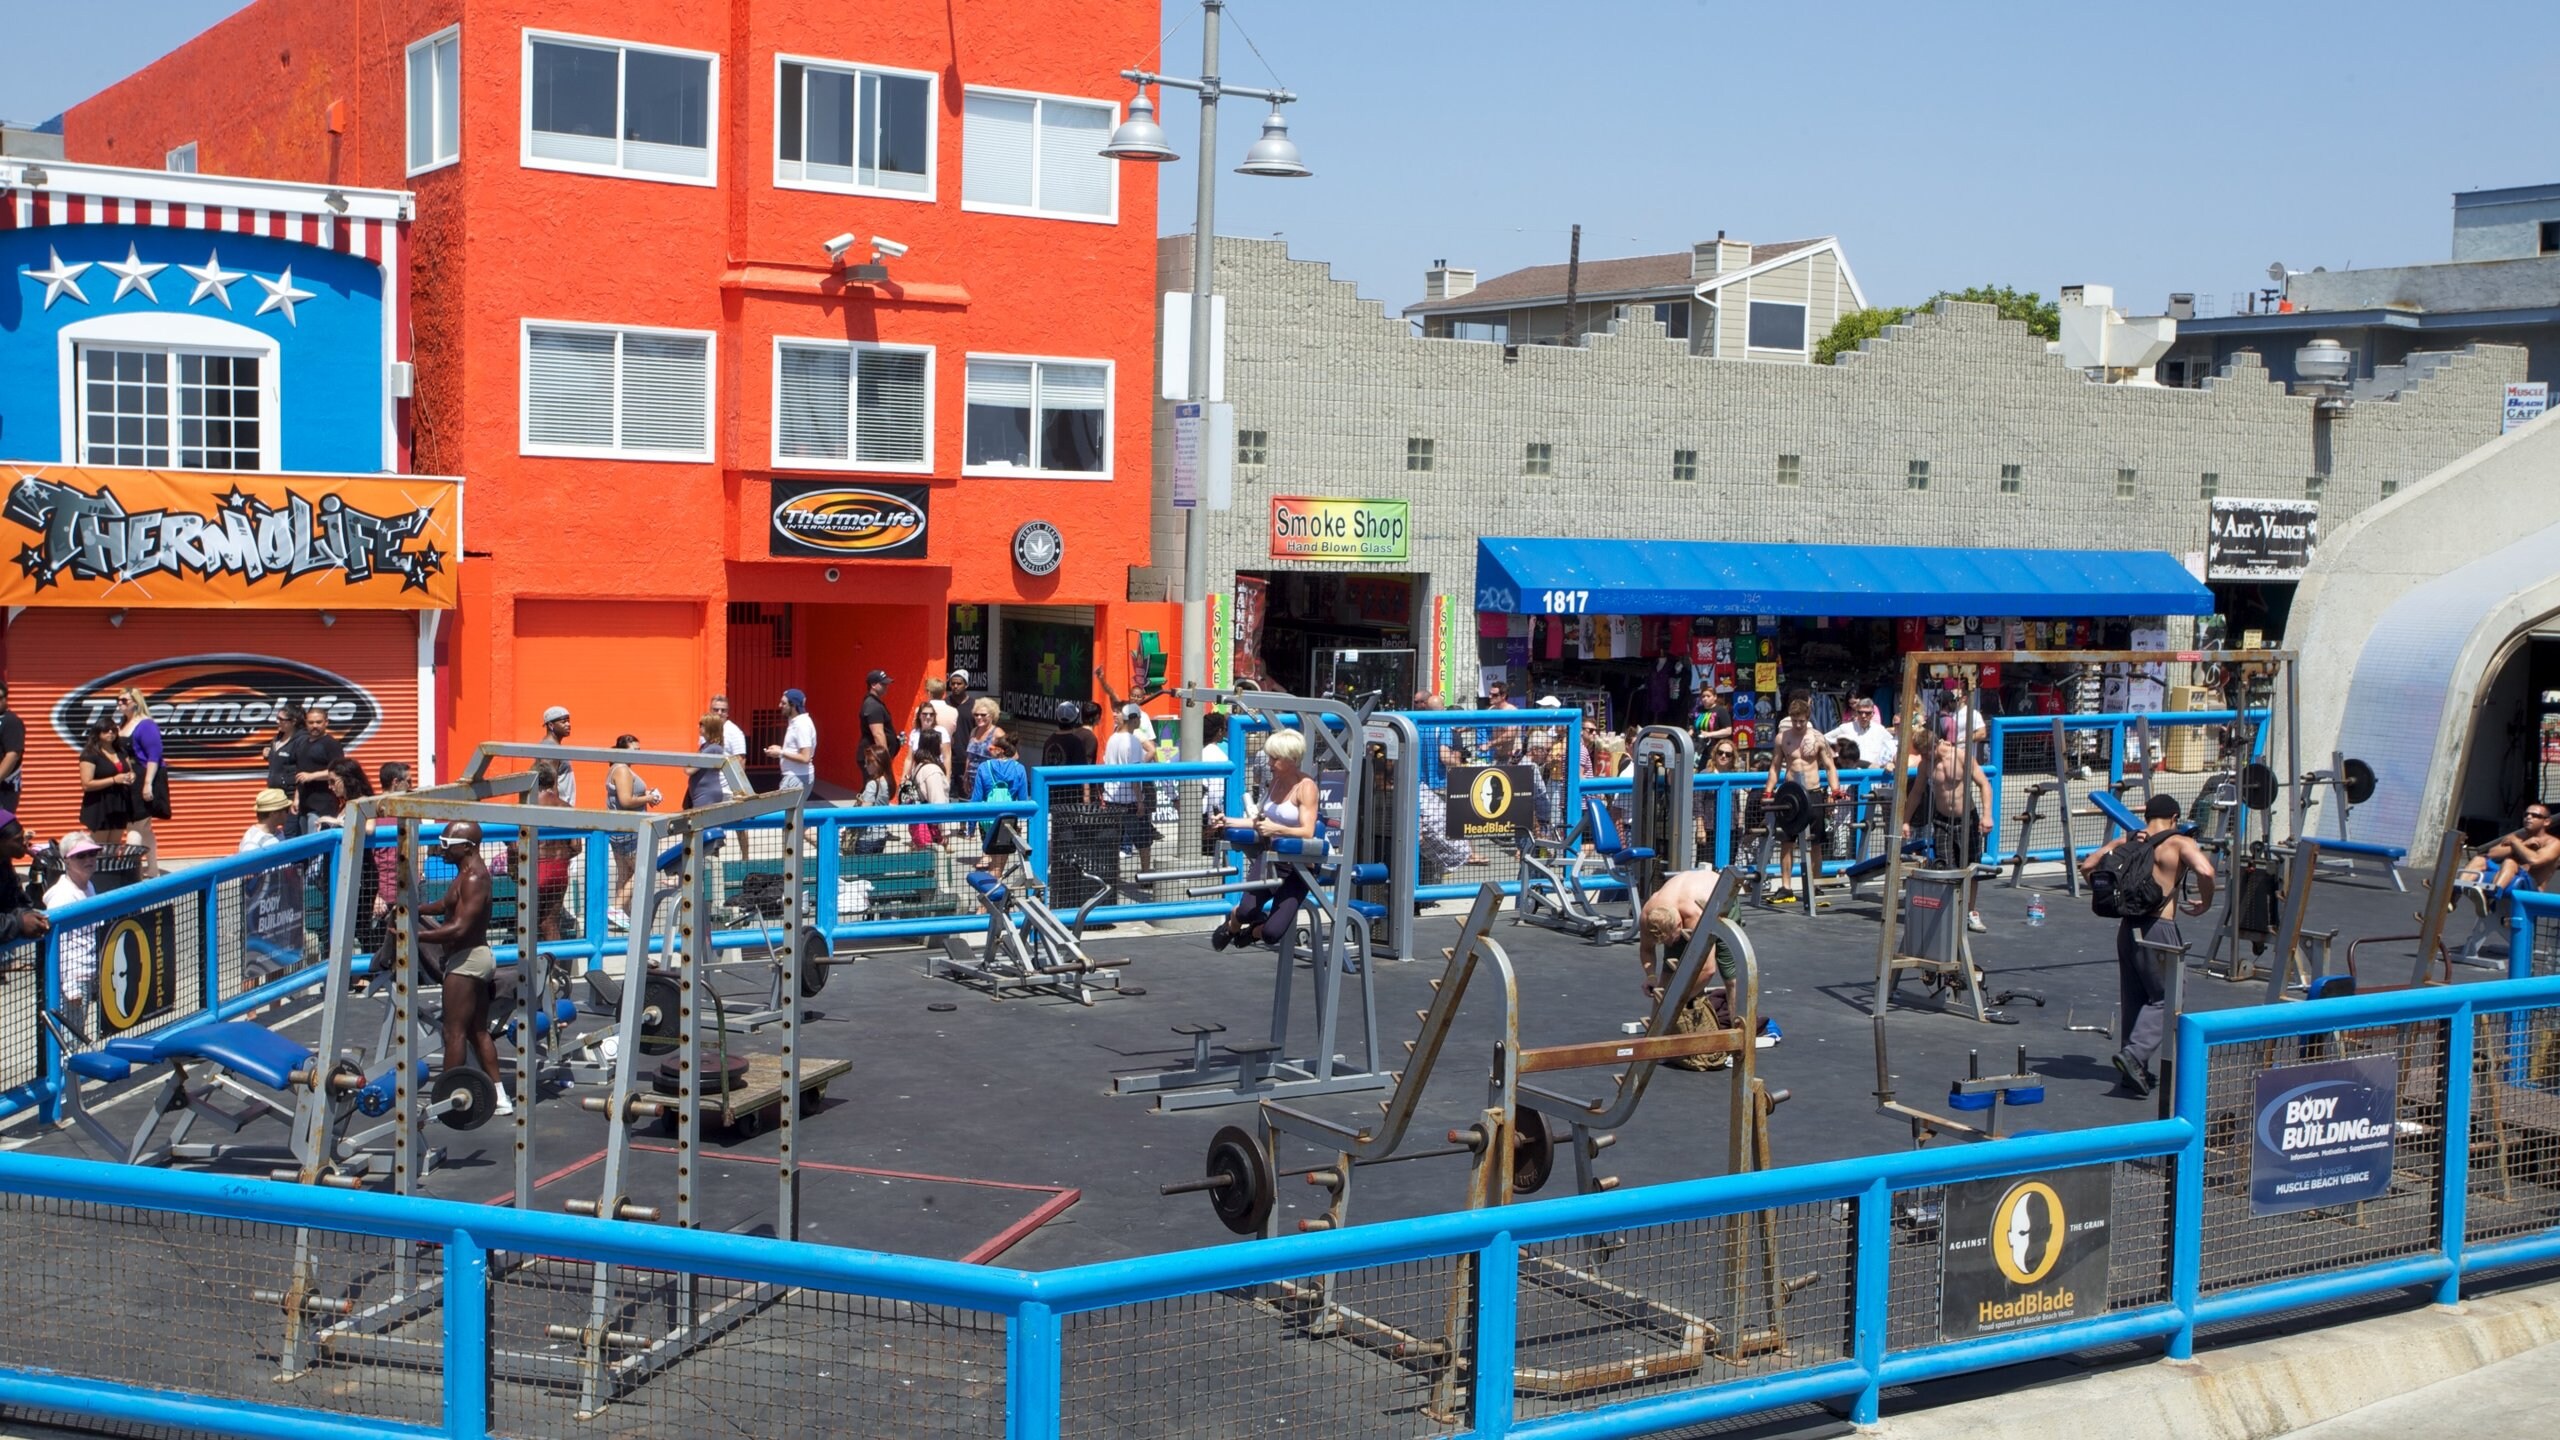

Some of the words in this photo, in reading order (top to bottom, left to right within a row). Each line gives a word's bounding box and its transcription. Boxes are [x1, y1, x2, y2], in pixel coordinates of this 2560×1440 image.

[2508, 387, 2544, 397] MUSCLE
[2508, 398, 2544, 407] BEACH
[783, 509, 916, 527] ThermoLife
[1277, 507, 1346, 537] Smoke
[1354, 509, 1403, 546] Shop
[2260, 515, 2306, 539] VENICE
[1287, 541, 1318, 552] Hand
[1321, 541, 1357, 553] Blown
[1360, 542, 1392, 553] Glass
[1543, 590, 1589, 613] 1817
[953, 635, 980, 650] VENICE
[1212, 611, 1222, 684] SMOKE
[1439, 611, 1448, 681] SMOKE
[953, 653, 979, 669] BEACH
[1003, 689, 1028, 715] VENICE
[1028, 694, 1054, 721] BEACH
[259, 895, 280, 915] BODY
[155, 911, 165, 1007] HeadBlade
[2285, 1096, 2339, 1124] BODY
[2276, 1180, 2310, 1195] MUSCLE
[2311, 1175, 2339, 1189] BEACH
[2340, 1170, 2370, 1184] VENICE
[1949, 1237, 1987, 1250] AGAINST
[2069, 1222, 2082, 1232] THE
[2084, 1219, 2105, 1230] GRAIN
[1979, 1286, 2074, 1323] HeadBlade
[1978, 1322, 1995, 1332] Proud
[1995, 1319, 2016, 1330] sponsor
[2016, 1317, 2023, 1325] of
[2023, 1315, 2042, 1324] Muscle
[2042, 1311, 2058, 1321] Beach
[2058, 1308, 2074, 1317] Venice
